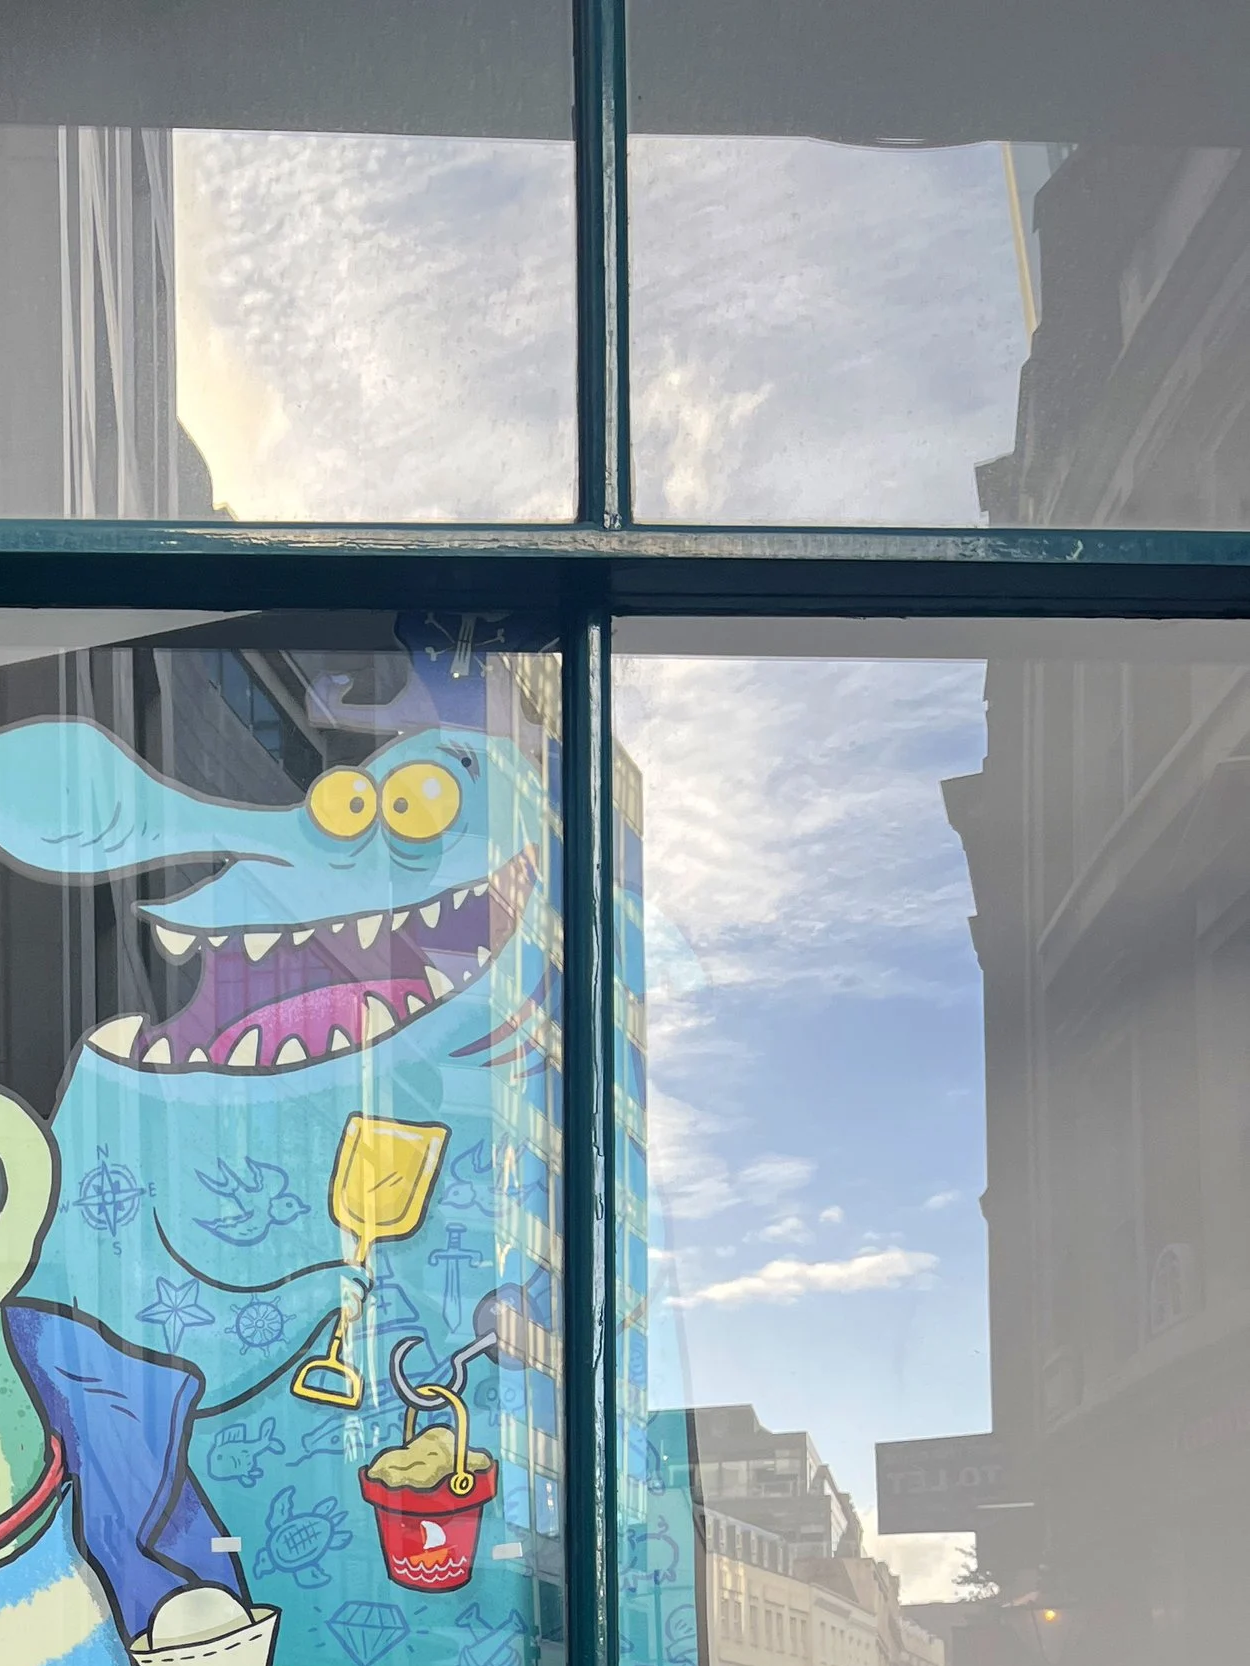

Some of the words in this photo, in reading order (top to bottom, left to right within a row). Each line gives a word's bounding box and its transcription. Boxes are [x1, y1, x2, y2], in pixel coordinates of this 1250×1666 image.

[96, 1143, 109, 1160] N
[59, 1201, 70, 1213] W
[148, 1182, 157, 1198] E
[112, 1241, 123, 1256] S
